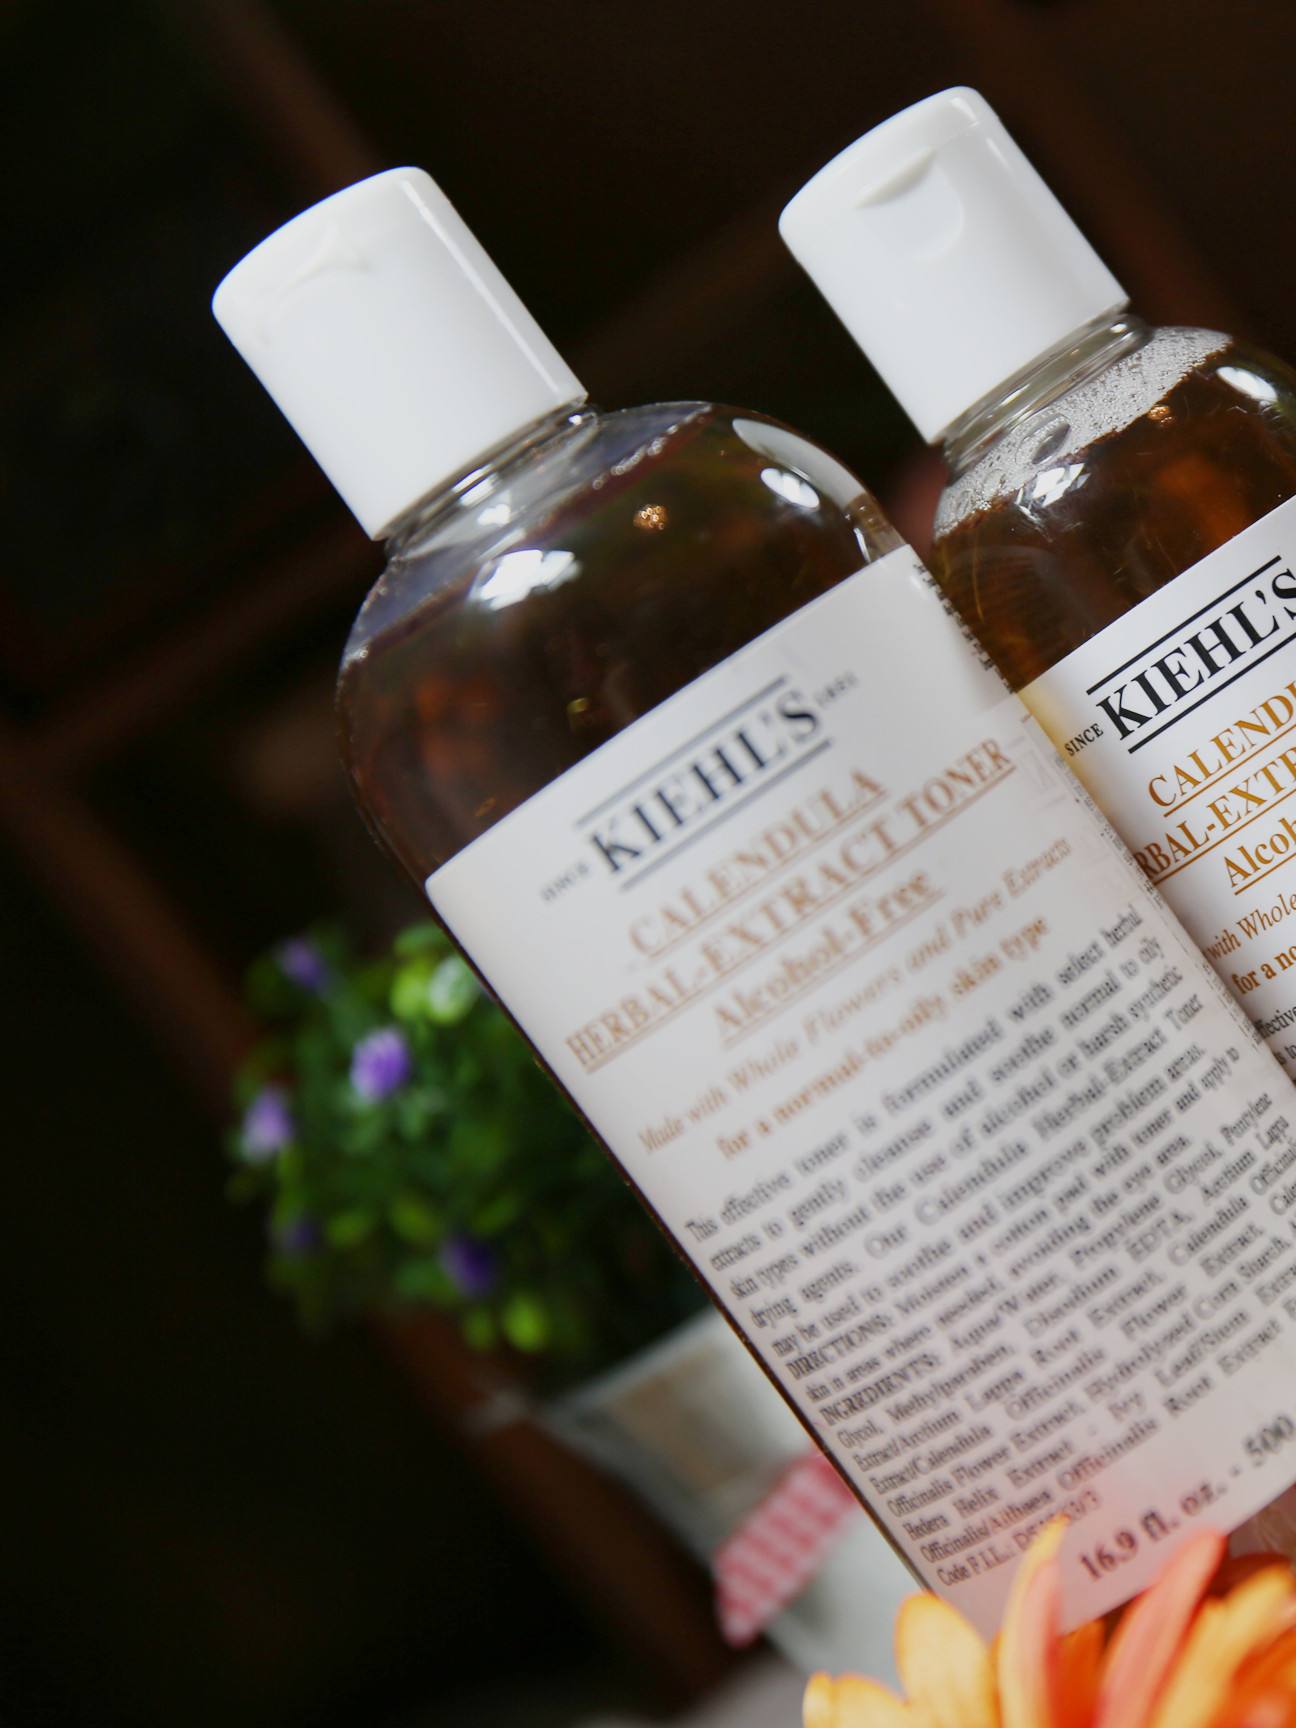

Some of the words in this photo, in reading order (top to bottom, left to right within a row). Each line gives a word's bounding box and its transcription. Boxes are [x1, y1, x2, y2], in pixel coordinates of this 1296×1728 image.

[591, 708, 818, 872] KIEHL'S
[1063, 722, 1104, 758] SINCE
[565, 816, 905, 1067] HERBAL-EXTRACT
[901, 740, 1011, 831] TONER
[629, 769, 887, 954] CALENDULA
[639, 1118, 685, 1152] Made
[686, 1087, 728, 1123] with
[910, 927, 951, 970] and
[951, 891, 1003, 936] Pure
[714, 874, 930, 1029] Alcohol-Free
[1200, 928, 1242, 967] with
[1230, 970, 1261, 997] for
[1260, 963, 1277, 980] a
[717, 1130, 750, 1159] for
[951, 955, 1001, 996] skin
[1001, 918, 1048, 957] type
[1080, 1530, 1138, 1580] 16.9
[1140, 1510, 1179, 1542] fl.
[1180, 1483, 1227, 1517] oz.
[1245, 1416, 1296, 1467] 500
